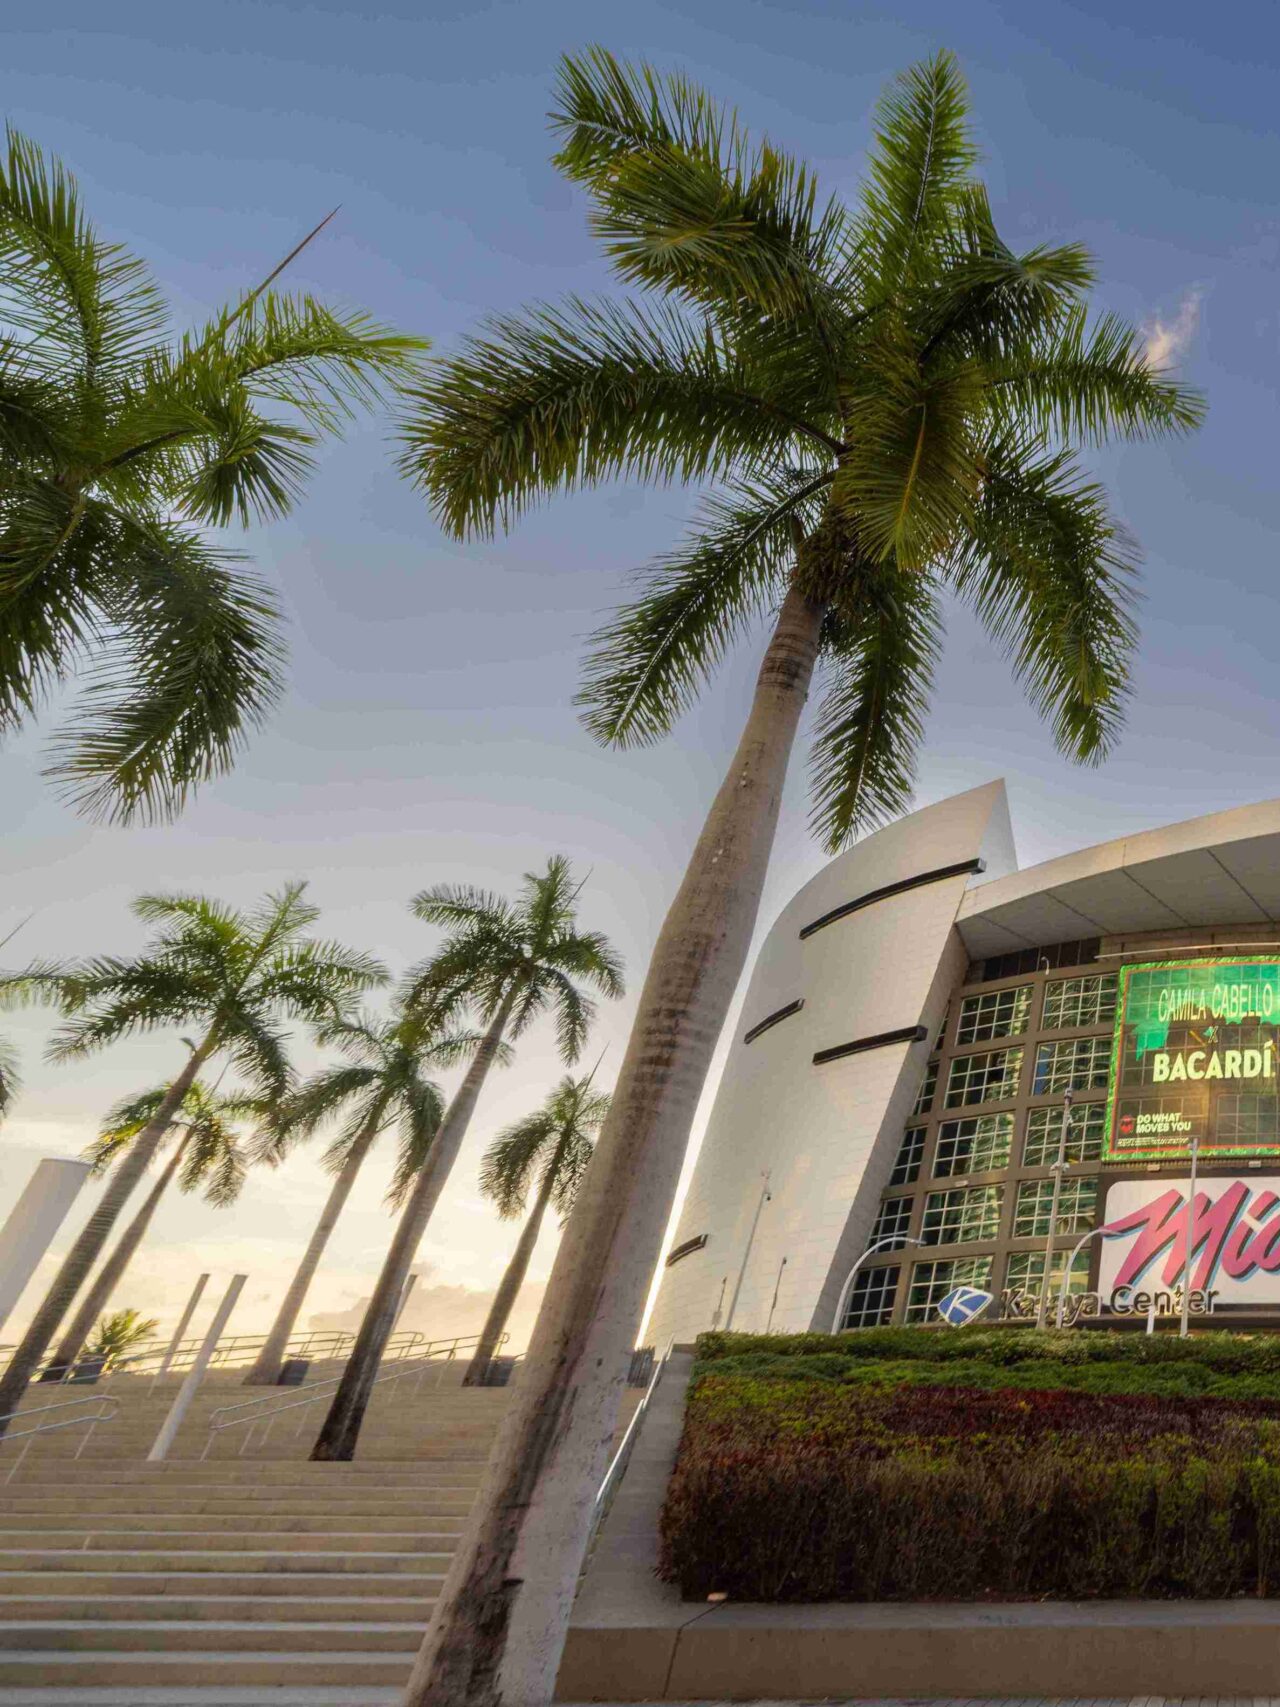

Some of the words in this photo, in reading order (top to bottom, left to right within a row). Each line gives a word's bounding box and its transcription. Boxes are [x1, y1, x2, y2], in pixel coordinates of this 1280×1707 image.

[1158, 988, 1207, 1022] CAMILA
[1211, 982, 1273, 1019] CABELLO
[1153, 1040, 1273, 1082] BACARDÍ
[1136, 1114, 1151, 1124] DO
[1152, 1112, 1182, 1123] WHAT
[1136, 1122, 1170, 1134] MOVES
[1171, 1121, 1191, 1132] YOU
[999, 1287, 1100, 1327] Kaeya
[1109, 1283, 1219, 1316] Center
